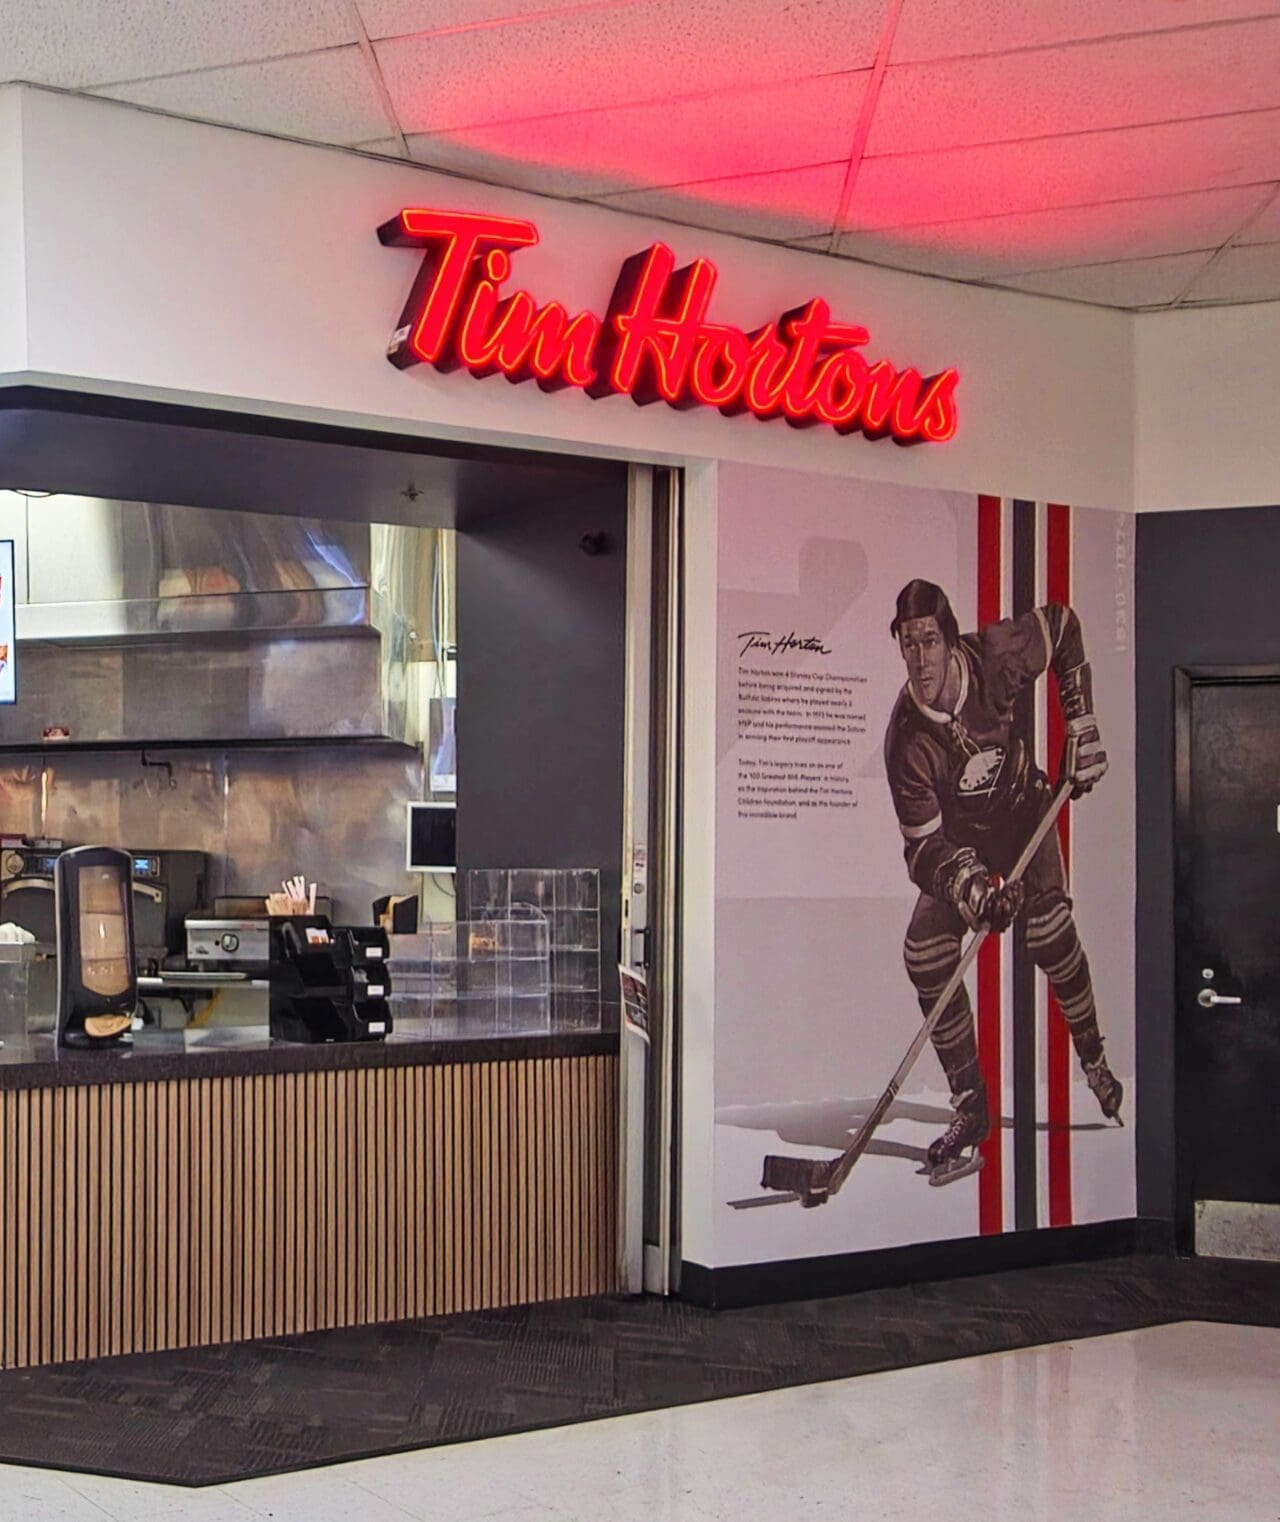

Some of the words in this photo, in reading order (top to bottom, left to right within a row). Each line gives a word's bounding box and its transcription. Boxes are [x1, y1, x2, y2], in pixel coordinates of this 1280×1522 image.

[382, 207, 599, 388] Tim
[600, 242, 959, 444] Hortons
[738, 631, 771, 657] Tim
